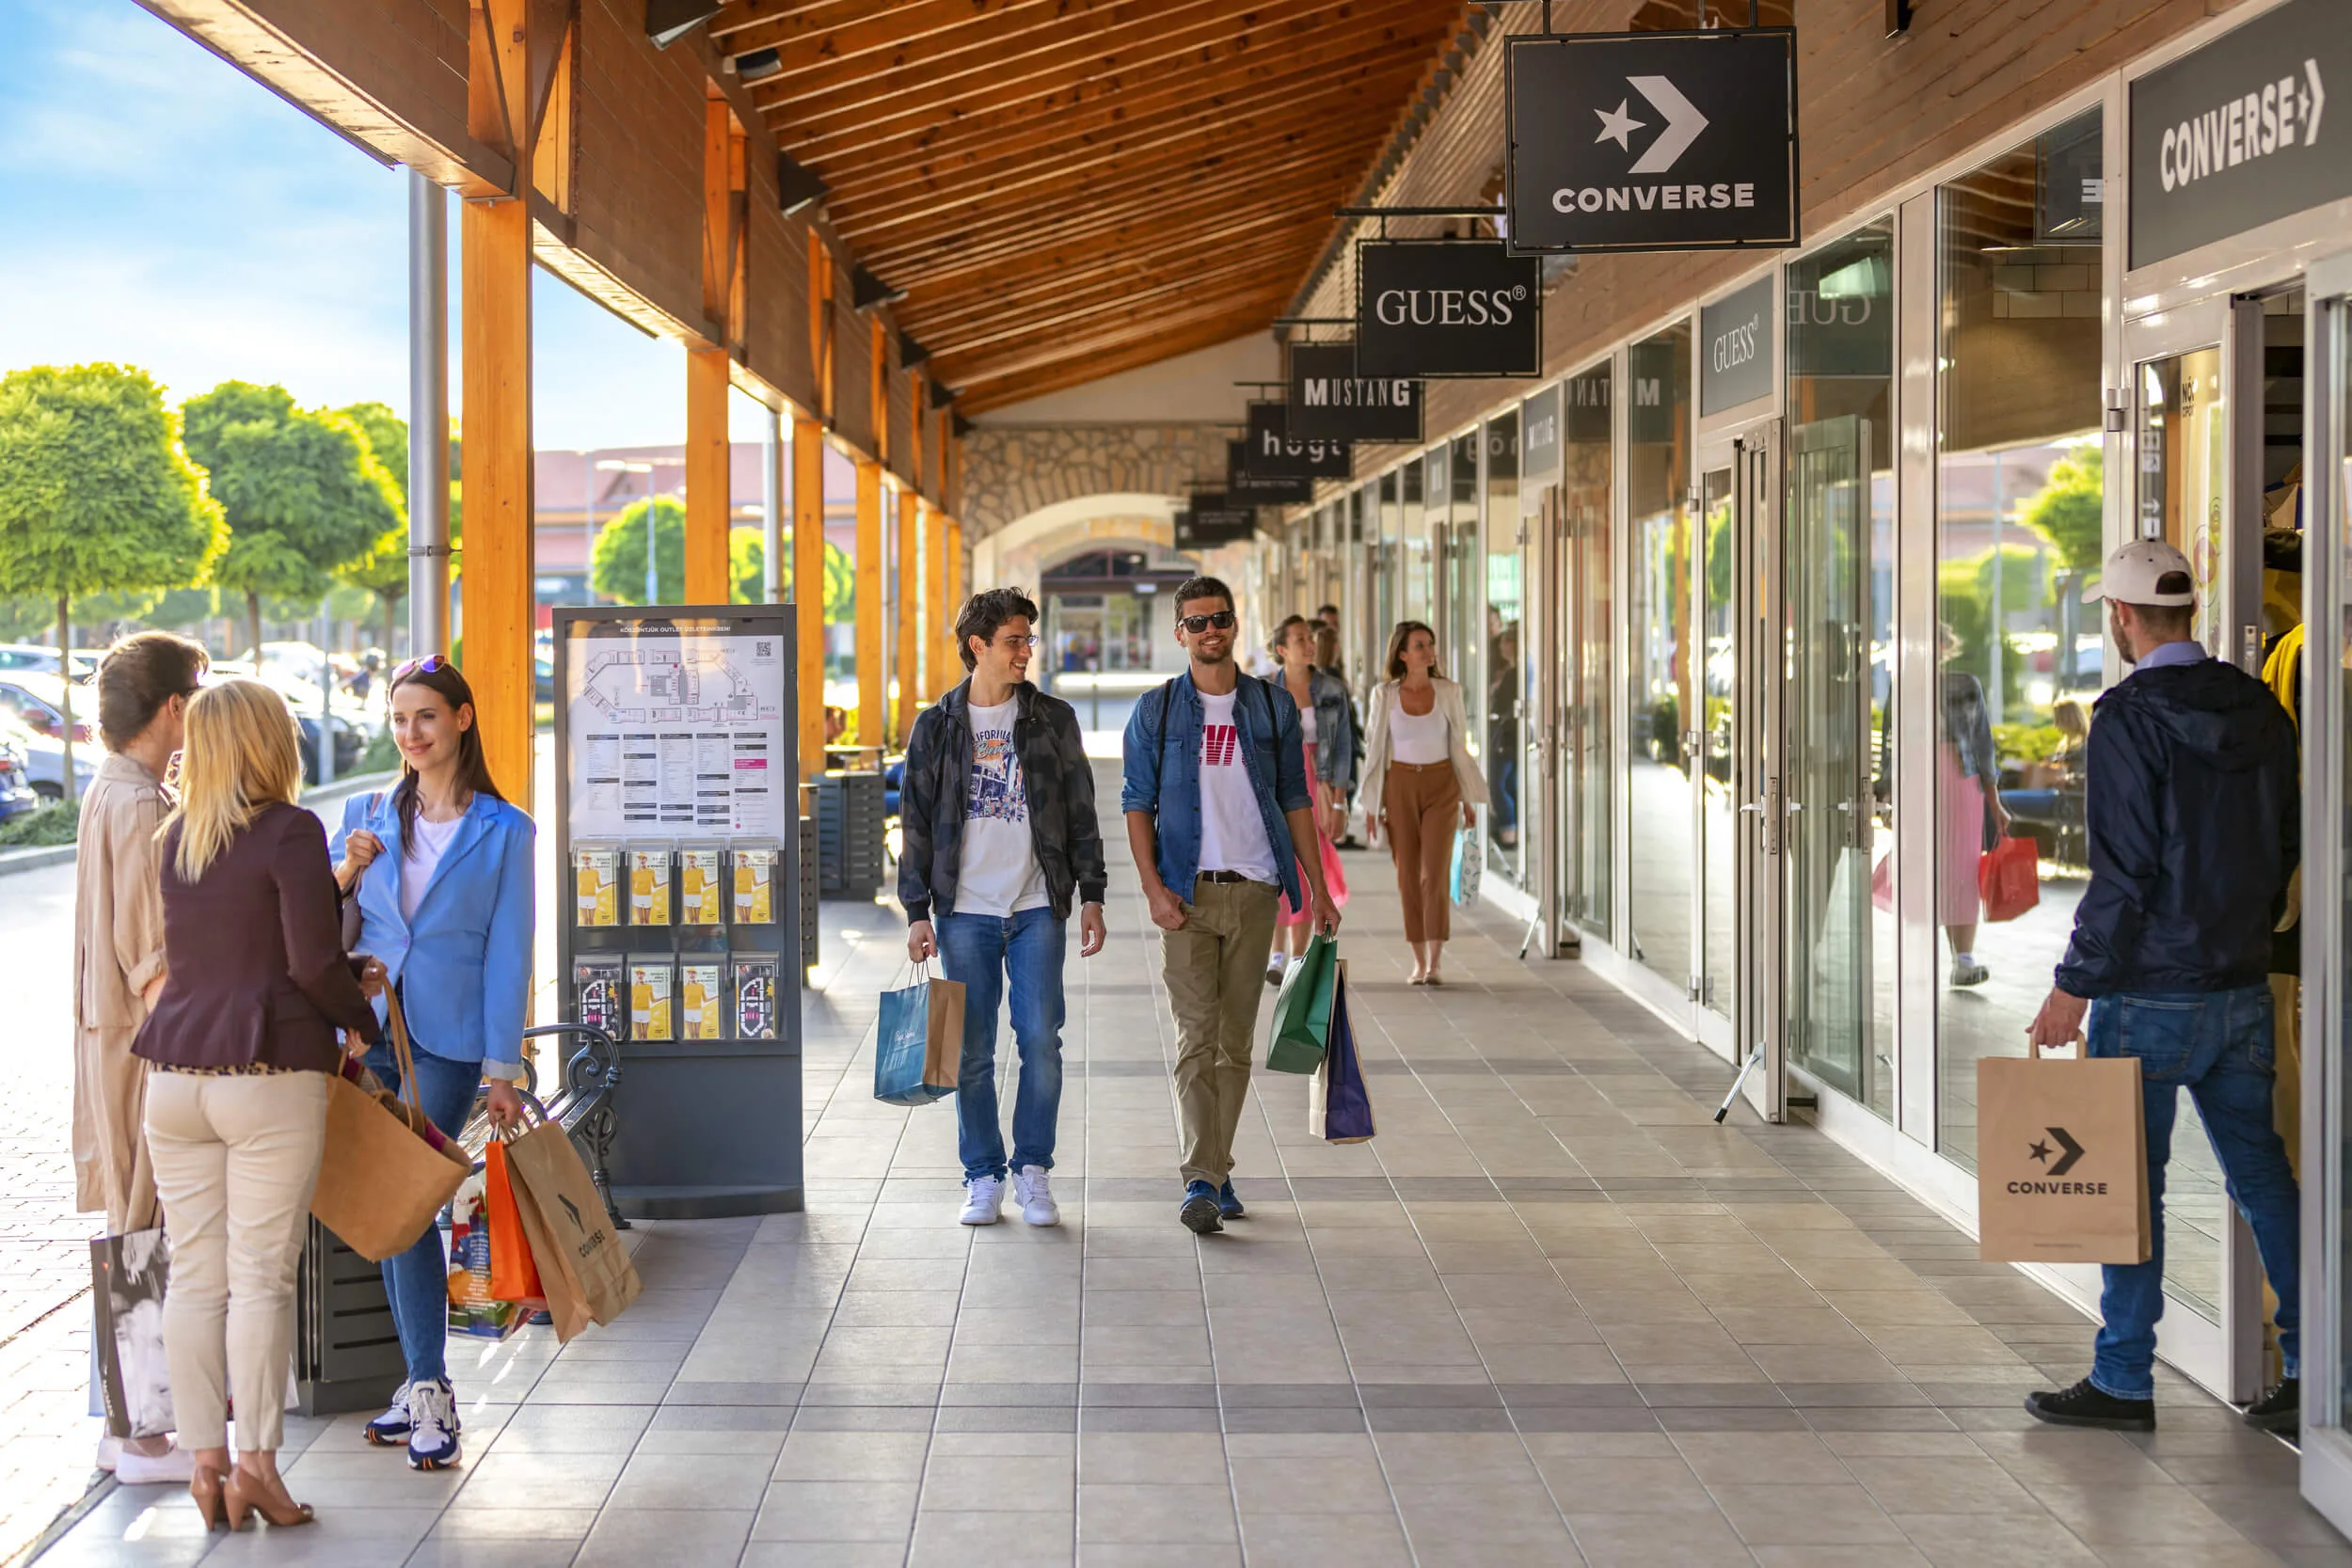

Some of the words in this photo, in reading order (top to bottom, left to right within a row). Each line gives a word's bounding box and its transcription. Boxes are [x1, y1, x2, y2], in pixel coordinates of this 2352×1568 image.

[2160, 75, 2295, 193] CONVERSE
[1551, 182, 1755, 214] CONVERSE
[1304, 378, 1410, 406] MUSTANG
[2007, 1181, 2107, 1195] CONVERSE
